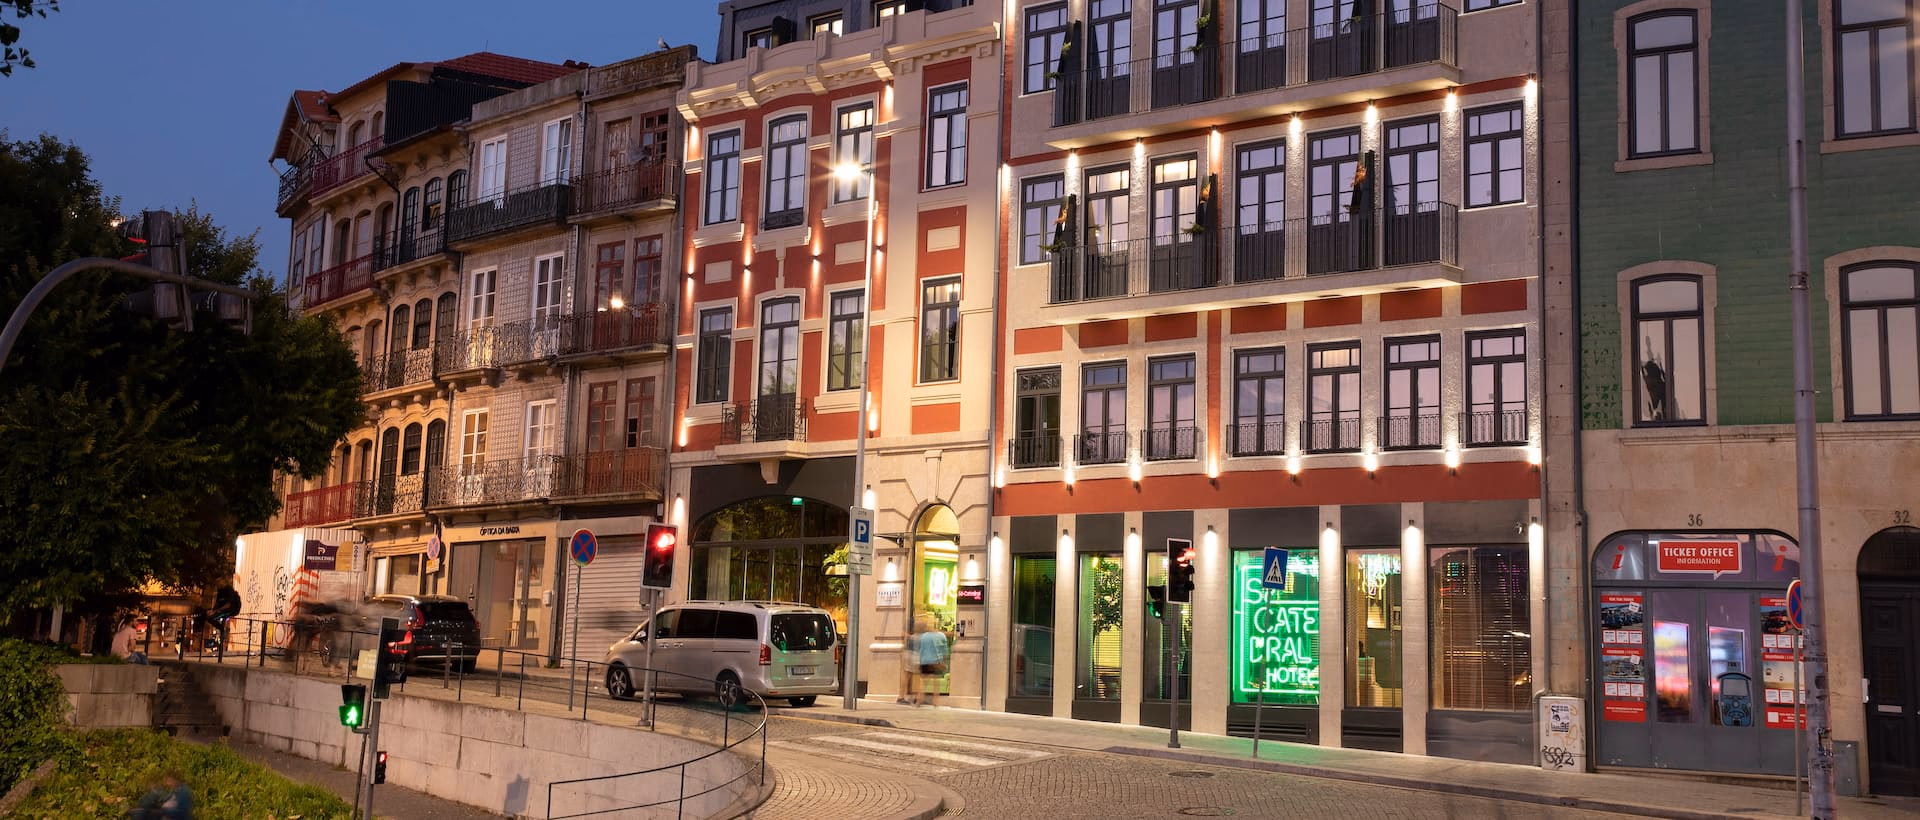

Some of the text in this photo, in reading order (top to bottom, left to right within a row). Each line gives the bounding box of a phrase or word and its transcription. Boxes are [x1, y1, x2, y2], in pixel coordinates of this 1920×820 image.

[1687, 513, 1703, 527] 36
[1893, 510, 1910, 524] 32
[857, 521, 867, 541] P
[1664, 547, 1734, 557] TICKET OFFICE
[1676, 557, 1721, 565] INFORMATION
[1254, 606, 1319, 634] CATE
[1249, 636, 1313, 664] DRAL
[1266, 667, 1319, 690] HOTEL
